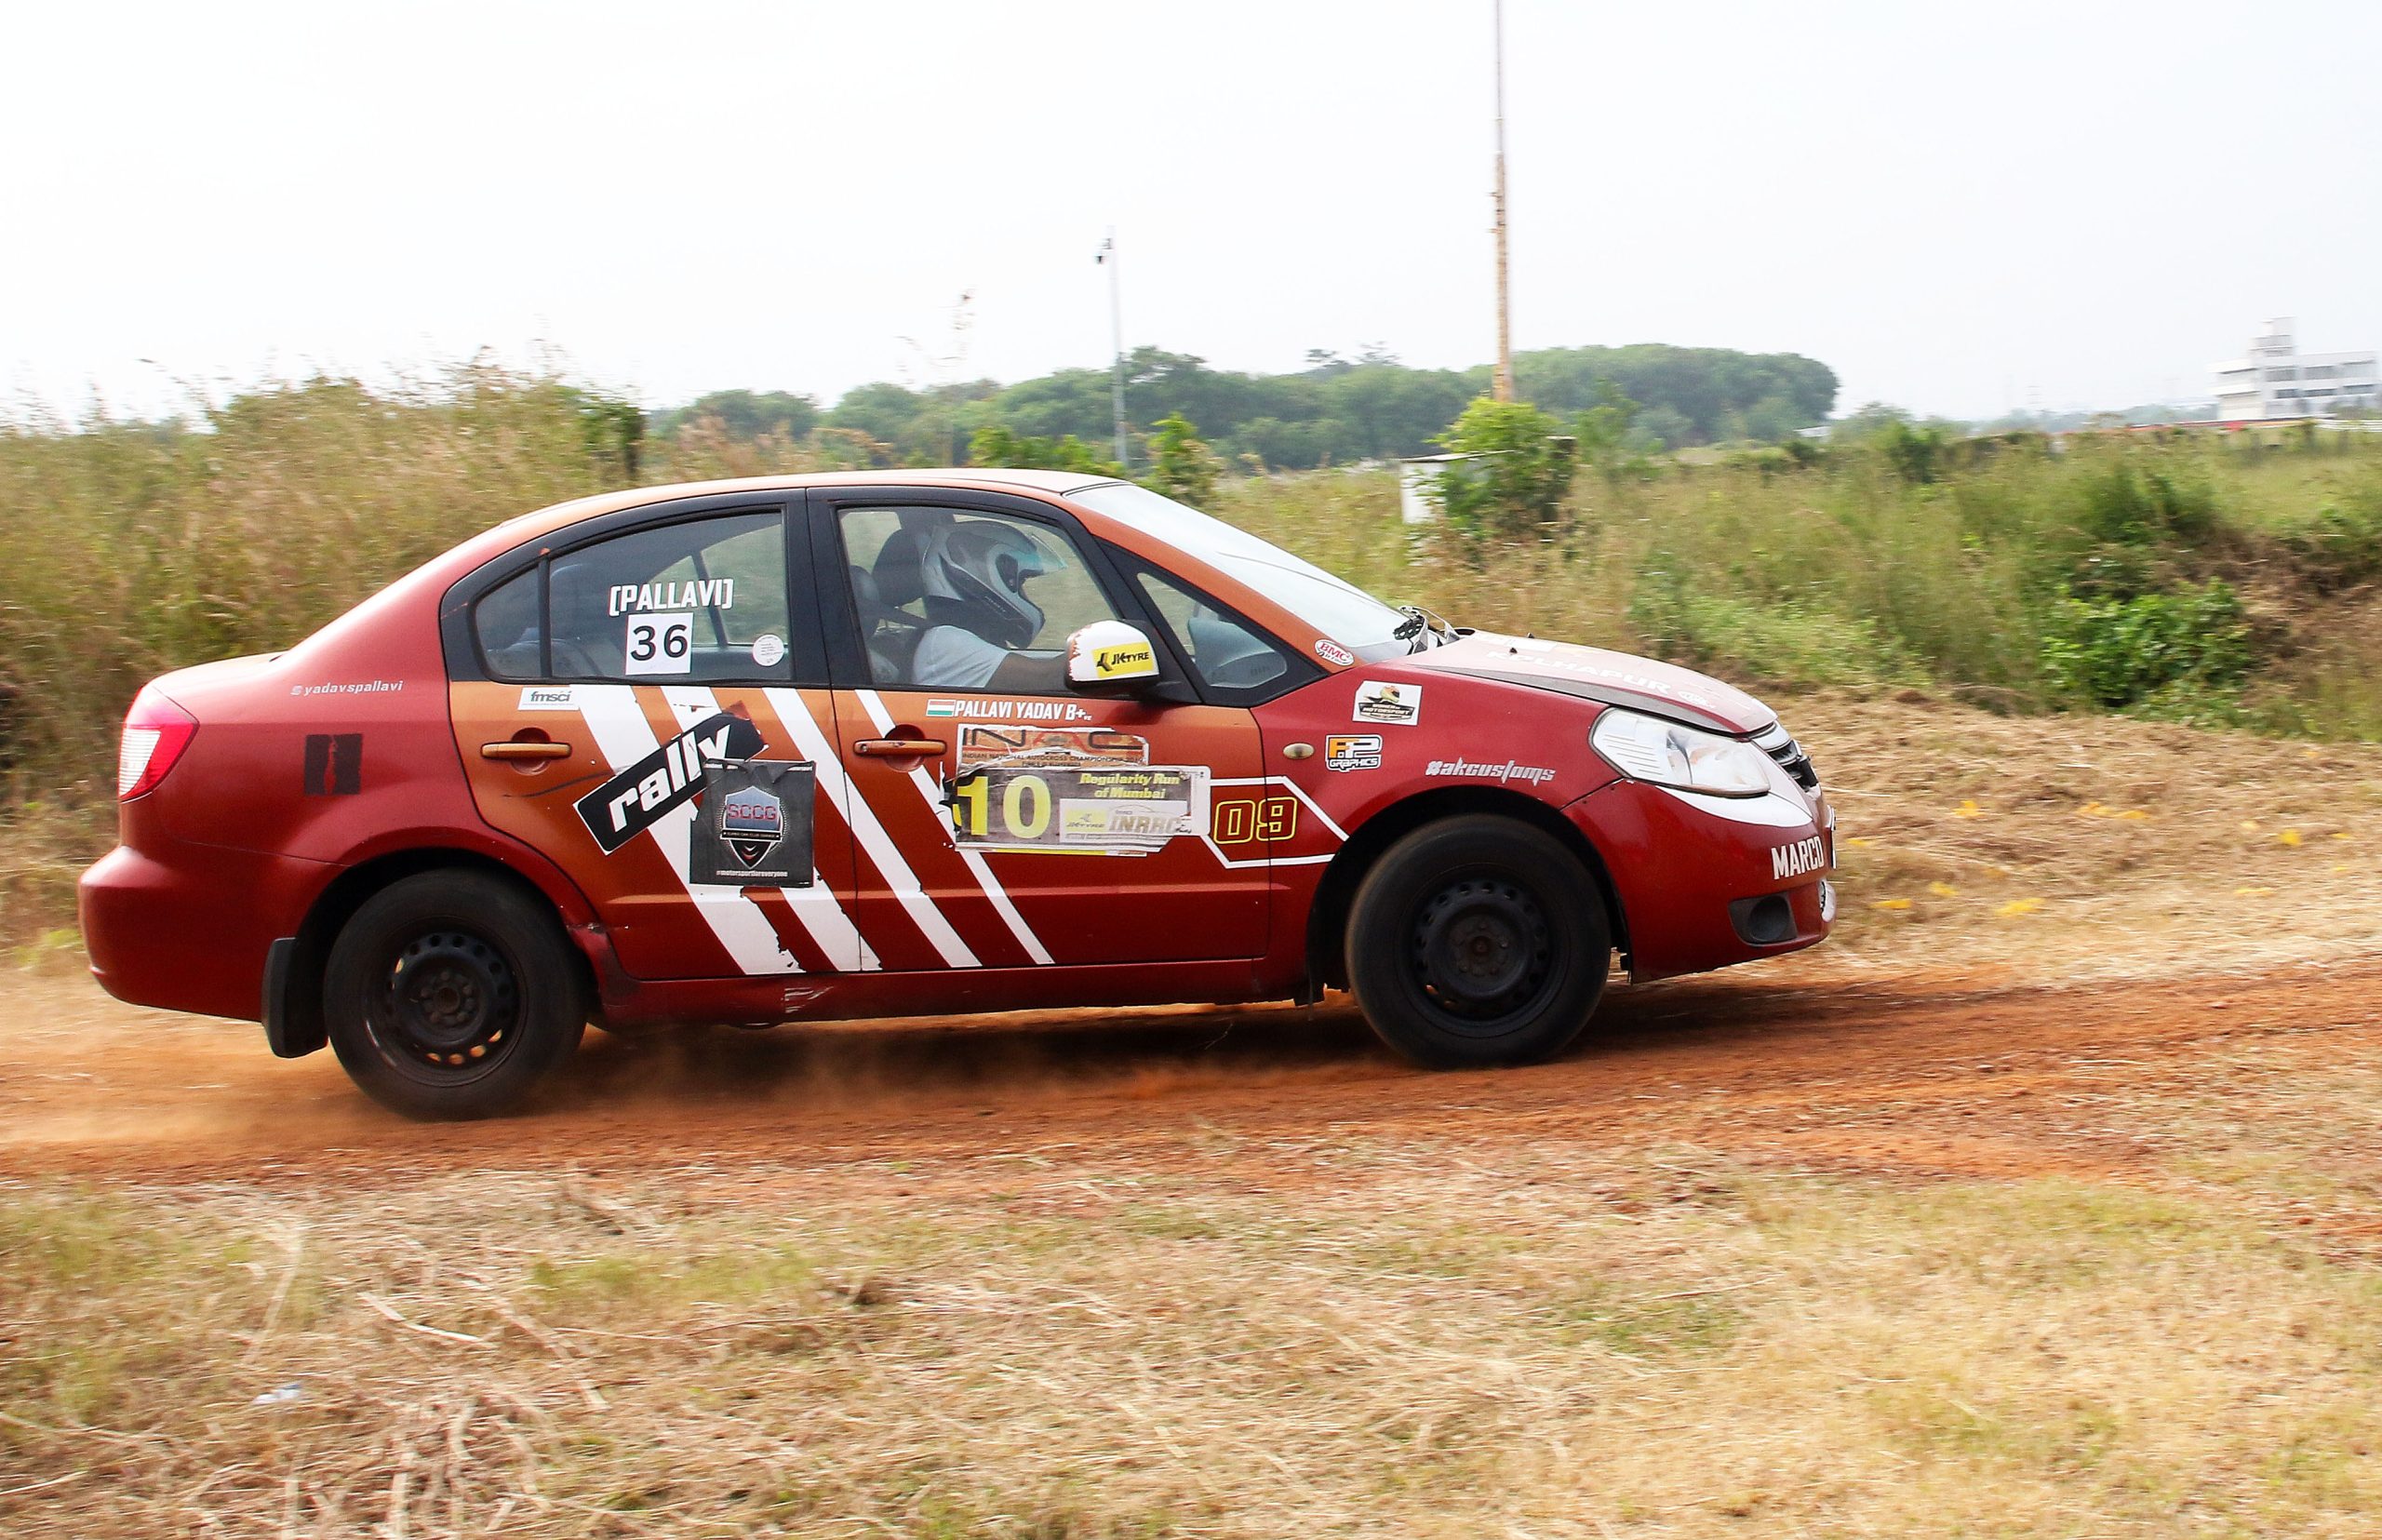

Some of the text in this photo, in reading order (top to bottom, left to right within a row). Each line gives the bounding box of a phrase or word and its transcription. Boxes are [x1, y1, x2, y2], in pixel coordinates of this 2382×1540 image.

[630, 623, 689, 662] 36
[1319, 642, 1350, 662] BMC
[530, 690, 572, 703] fmsci
[954, 700, 1012, 718] PALLAVI
[1015, 702, 1064, 720] YADAV
[1362, 707, 1411, 716] MOTORSPORT
[609, 724, 730, 833] rally
[1078, 772, 1181, 785] Regularity Run
[1094, 787, 1167, 799] of Mumbai
[728, 803, 777, 821] SCCG
[957, 774, 1051, 839] 10
[1213, 796, 1298, 845] 09
[1771, 836, 1825, 879] MARCO
